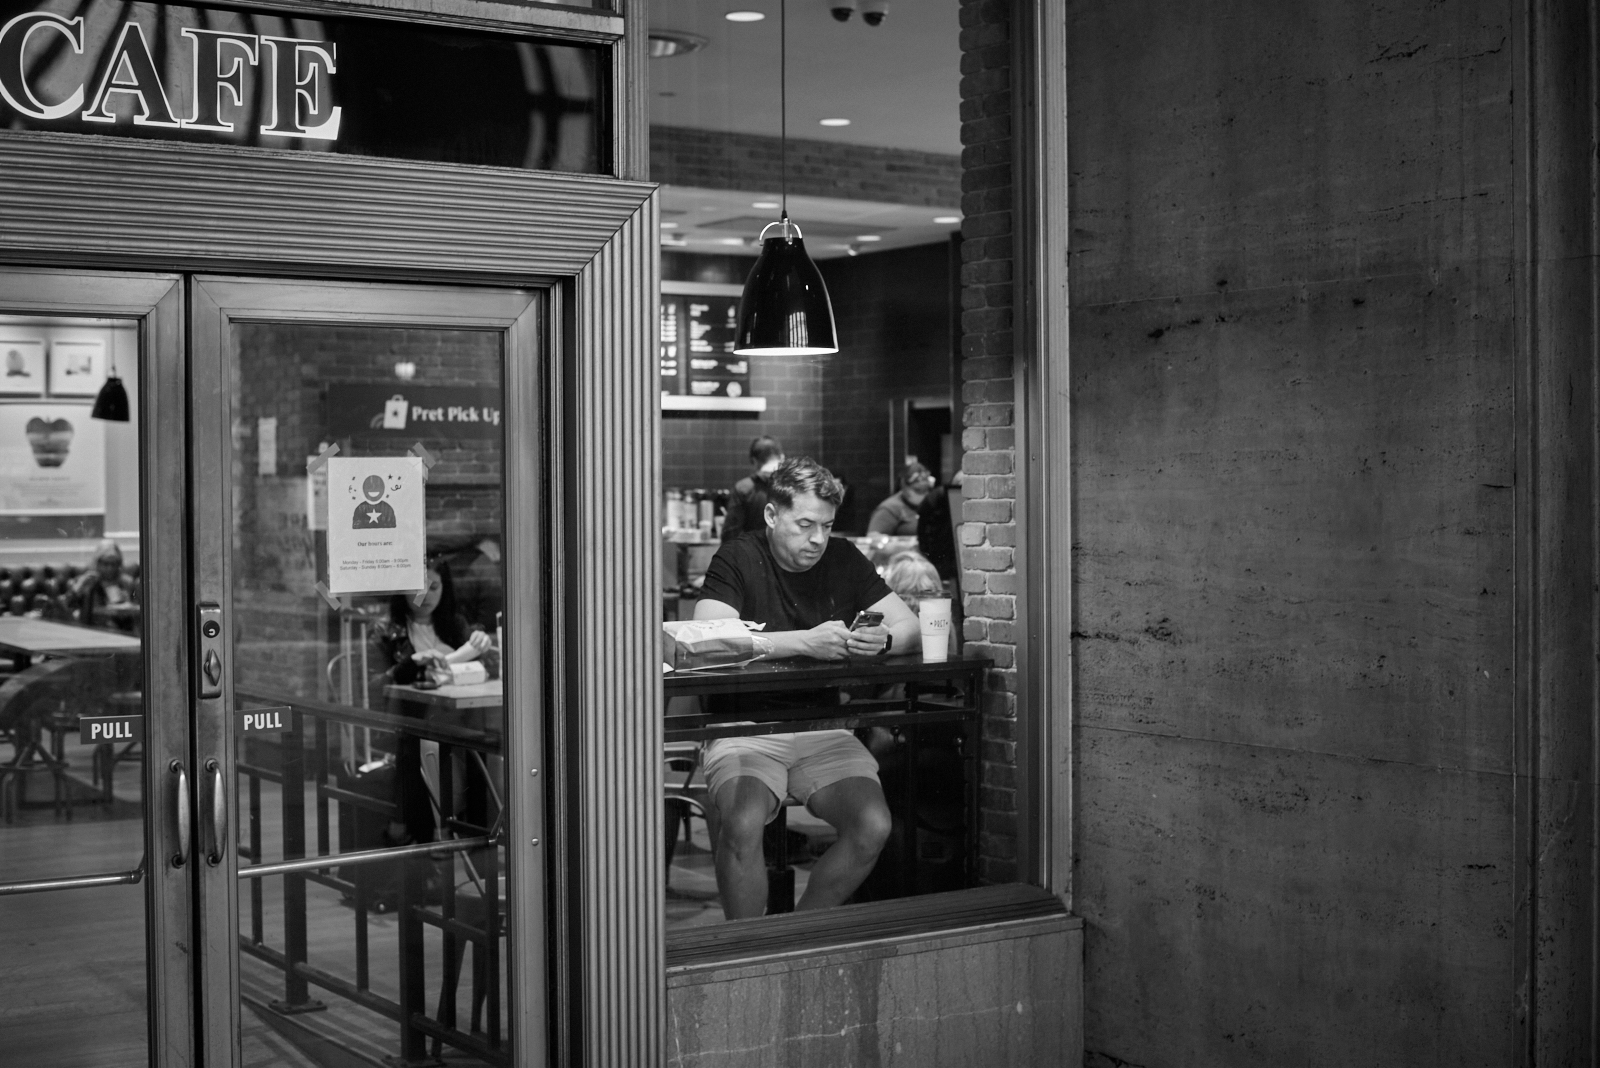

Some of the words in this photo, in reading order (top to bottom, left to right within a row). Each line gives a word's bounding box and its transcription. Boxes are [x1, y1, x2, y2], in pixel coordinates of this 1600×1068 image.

[0, 12, 342, 140] CAFE
[412, 406, 444, 421] Pret
[447, 406, 479, 422] Pick
[91, 721, 133, 740] PULL
[243, 712, 282, 731] PULL
